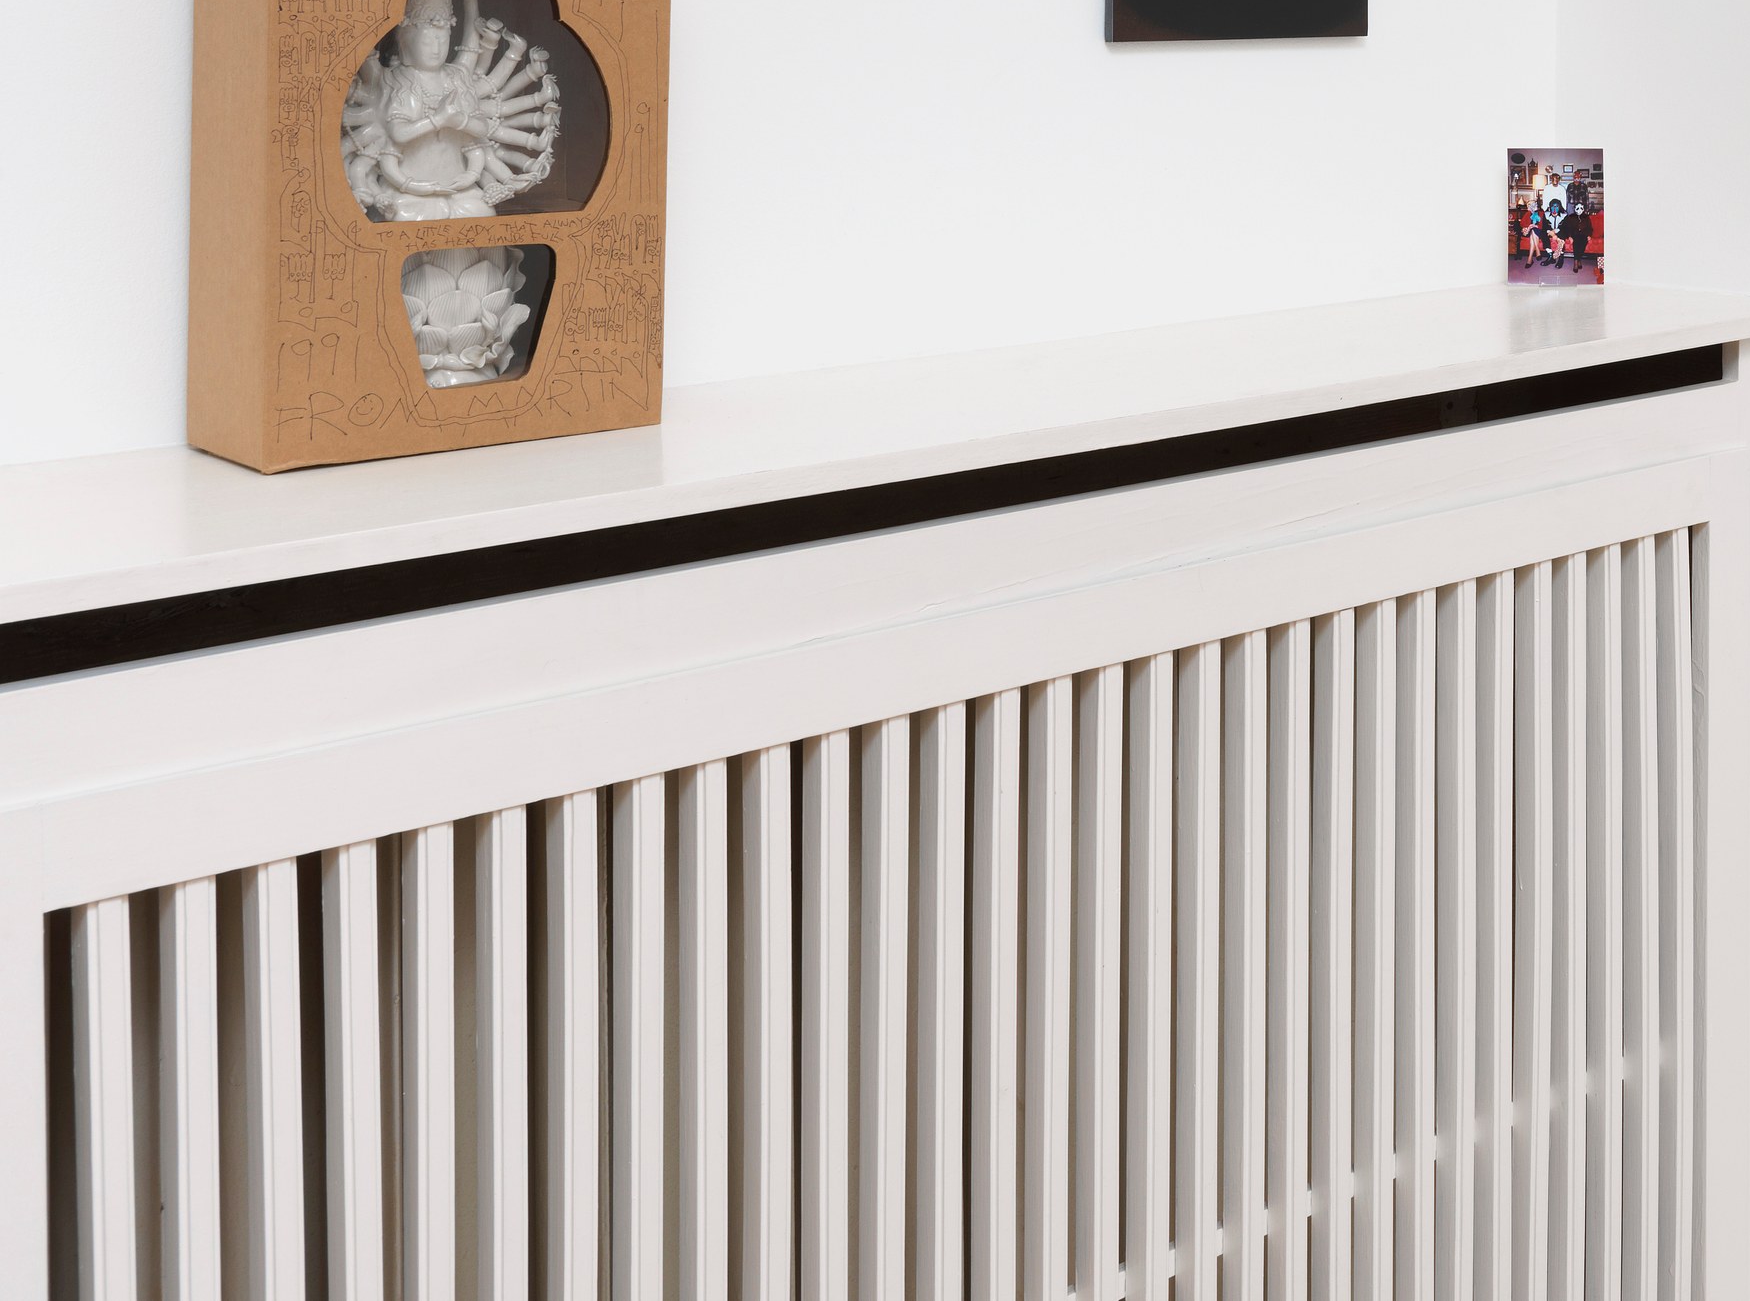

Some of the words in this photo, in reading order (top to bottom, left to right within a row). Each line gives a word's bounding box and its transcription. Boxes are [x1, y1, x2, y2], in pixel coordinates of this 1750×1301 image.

[376, 230, 394, 243] TO
[399, 230, 411, 240] A
[459, 223, 495, 238] LADY
[500, 220, 537, 235] THAT
[543, 213, 594, 230] ALWAYS
[405, 239, 437, 252] HAS
[445, 236, 476, 248] HER
[531, 230, 564, 243] FULL
[276, 332, 361, 394] 1991
[272, 390, 442, 444] FROM
[461, 373, 650, 438] MARTIN
